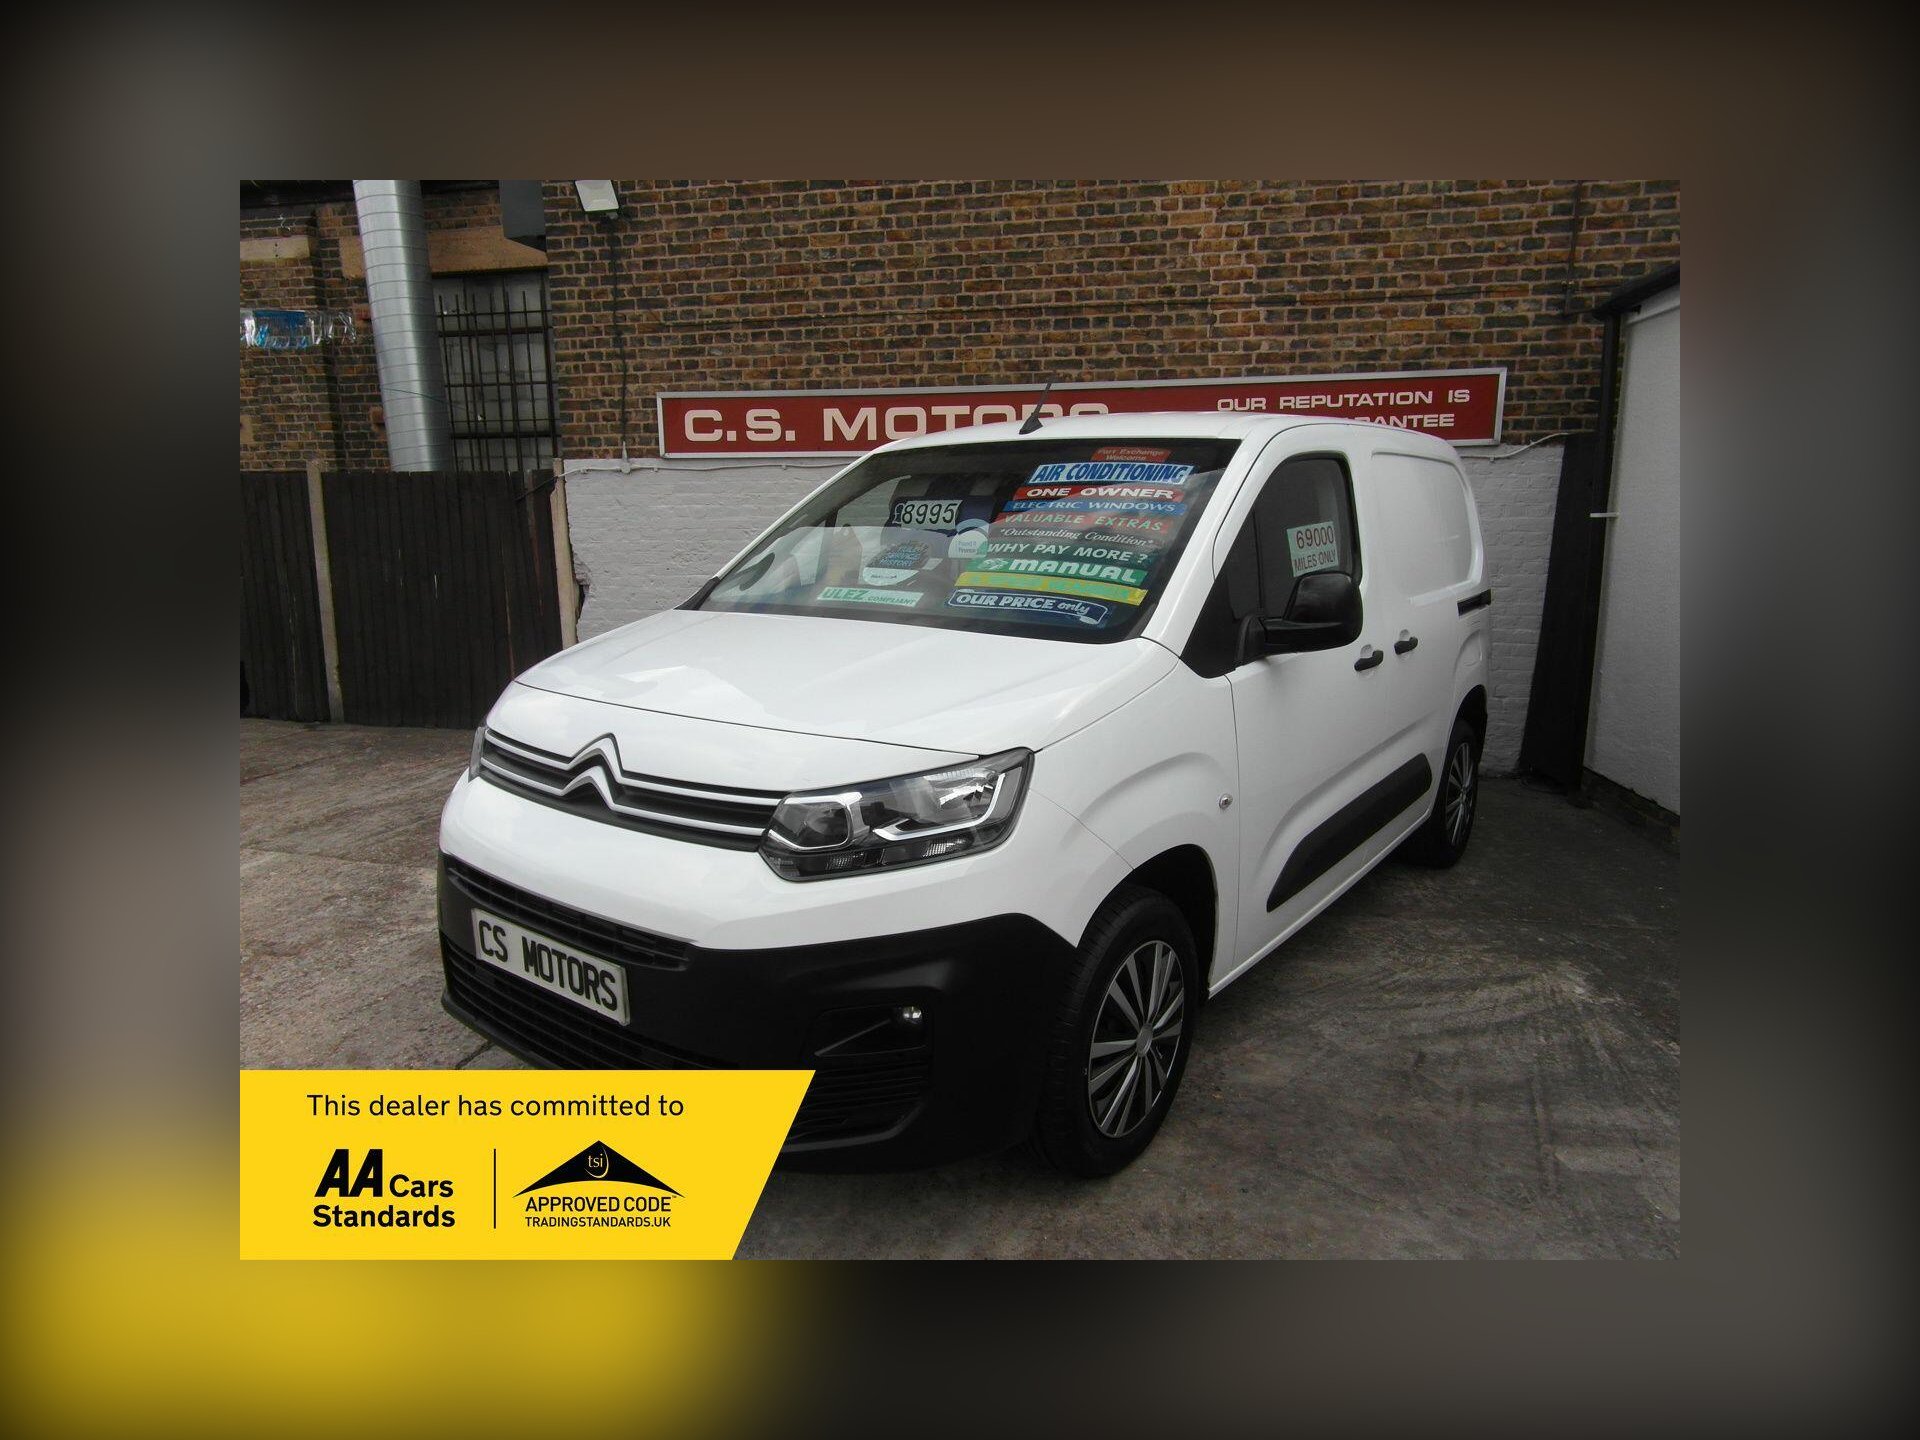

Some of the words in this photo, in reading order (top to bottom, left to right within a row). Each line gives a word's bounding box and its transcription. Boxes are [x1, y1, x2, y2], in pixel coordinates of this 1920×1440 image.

[1217, 398, 1267, 412] OUR
[1279, 390, 1433, 410] REPUTATION
[1448, 389, 1471, 403] IS
[684, 408, 796, 442] C.S.
[1354, 413, 1455, 428] ANTEE
[1034, 464, 1063, 482] AIR
[1066, 463, 1189, 484] CONDITIONING
[1026, 488, 1072, 498] ONE
[1080, 487, 1175, 499] OWNER
[1012, 501, 1081, 511] ELECTRIC
[1088, 501, 1176, 512] WINDOWS
[1004, 513, 1085, 525] VALUABLE
[1094, 515, 1163, 532] EXTRAS
[1296, 525, 1334, 549] 69000
[989, 543, 1030, 553] WHY
[1033, 543, 1071, 555] PAY
[1073, 546, 1134, 562] MORE
[1295, 553, 1318, 572] MILES
[1319, 549, 1336, 566] ONLY
[1009, 558, 1137, 584] MANUAL
[822, 587, 869, 601] ULEZ
[868, 595, 916, 605] COMPLIANT
[956, 593, 998, 606] OUR
[999, 595, 1054, 610] PRICE
[1056, 601, 1090, 616] only
[478, 919, 508, 963] CS
[521, 936, 618, 1012] MOTORS
